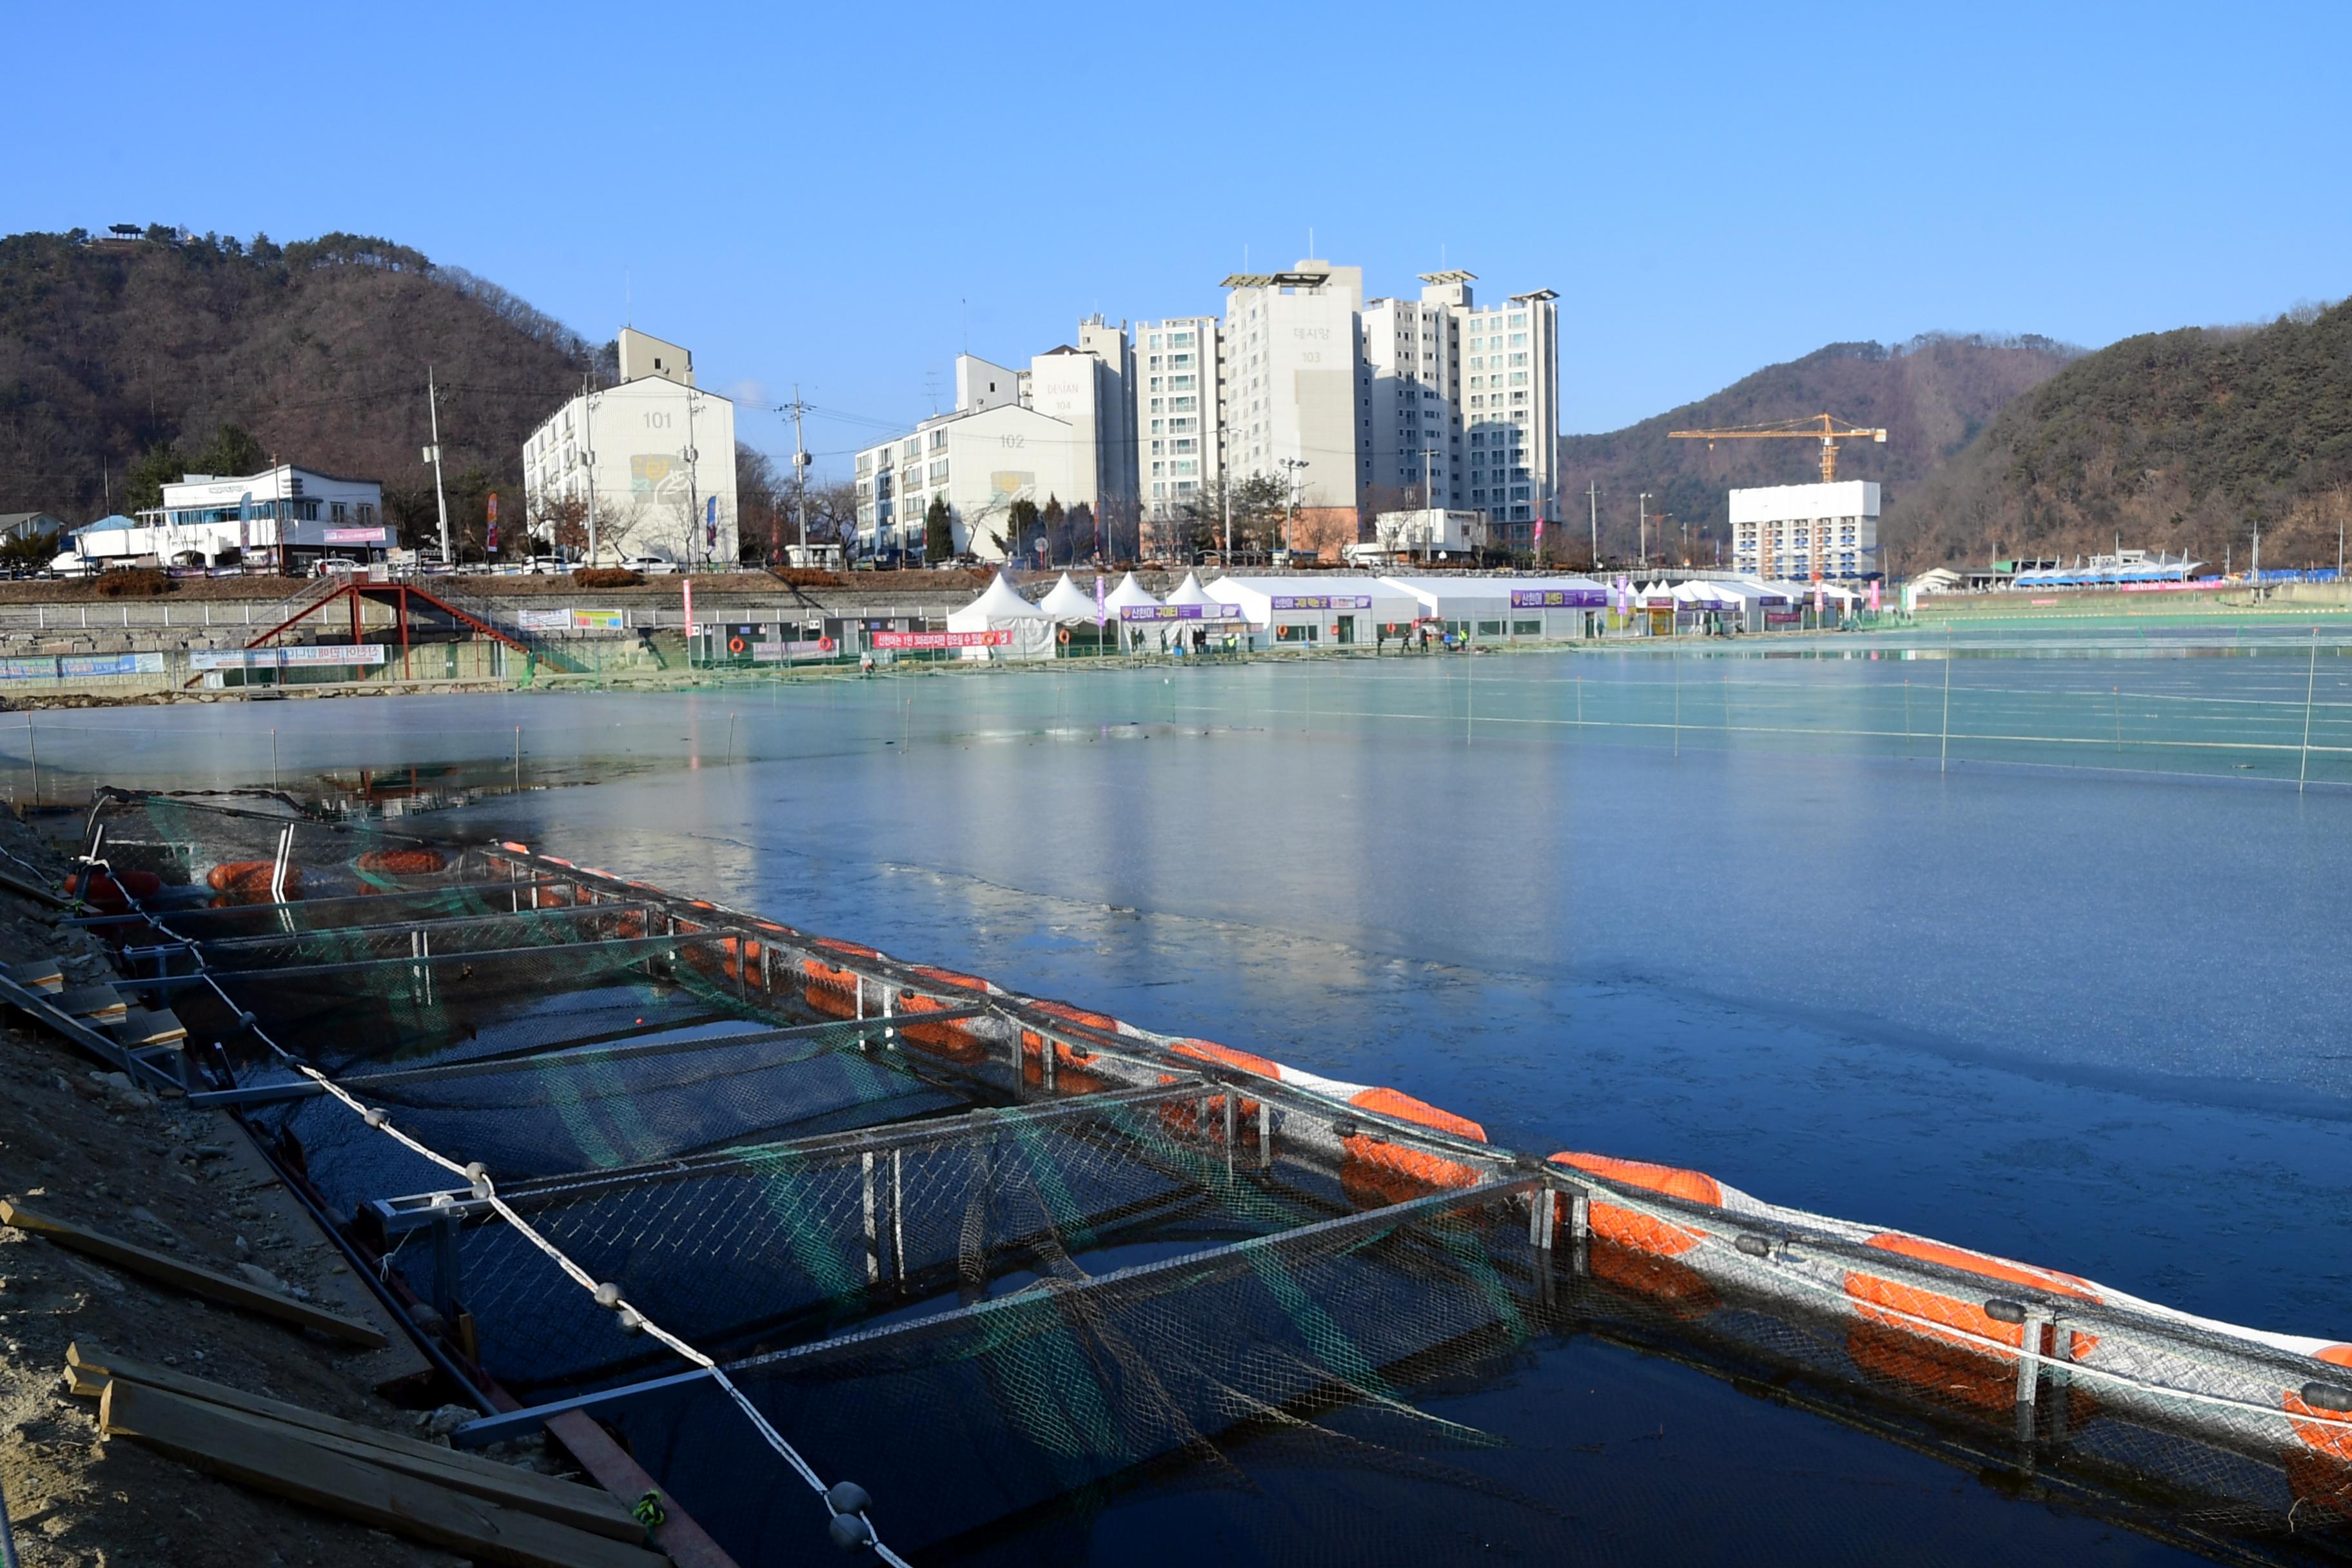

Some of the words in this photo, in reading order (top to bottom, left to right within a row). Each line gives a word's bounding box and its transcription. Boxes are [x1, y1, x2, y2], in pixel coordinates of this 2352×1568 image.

[1294, 328, 1330, 340] 데시앙
[1302, 351, 1321, 363] 103
[1057, 402, 1072, 410] 104
[643, 411, 671, 428] 101
[1000, 434, 1025, 449] 102
[1522, 592, 1542, 606] 산천어
[1132, 607, 1154, 619] 산천어
[1155, 606, 1178, 618] 구이터
[879, 634, 902, 646] 산천어는
[904, 634, 913, 646] 1인
[946, 633, 963, 646] 잡으실
[964, 633, 970, 645] 수
